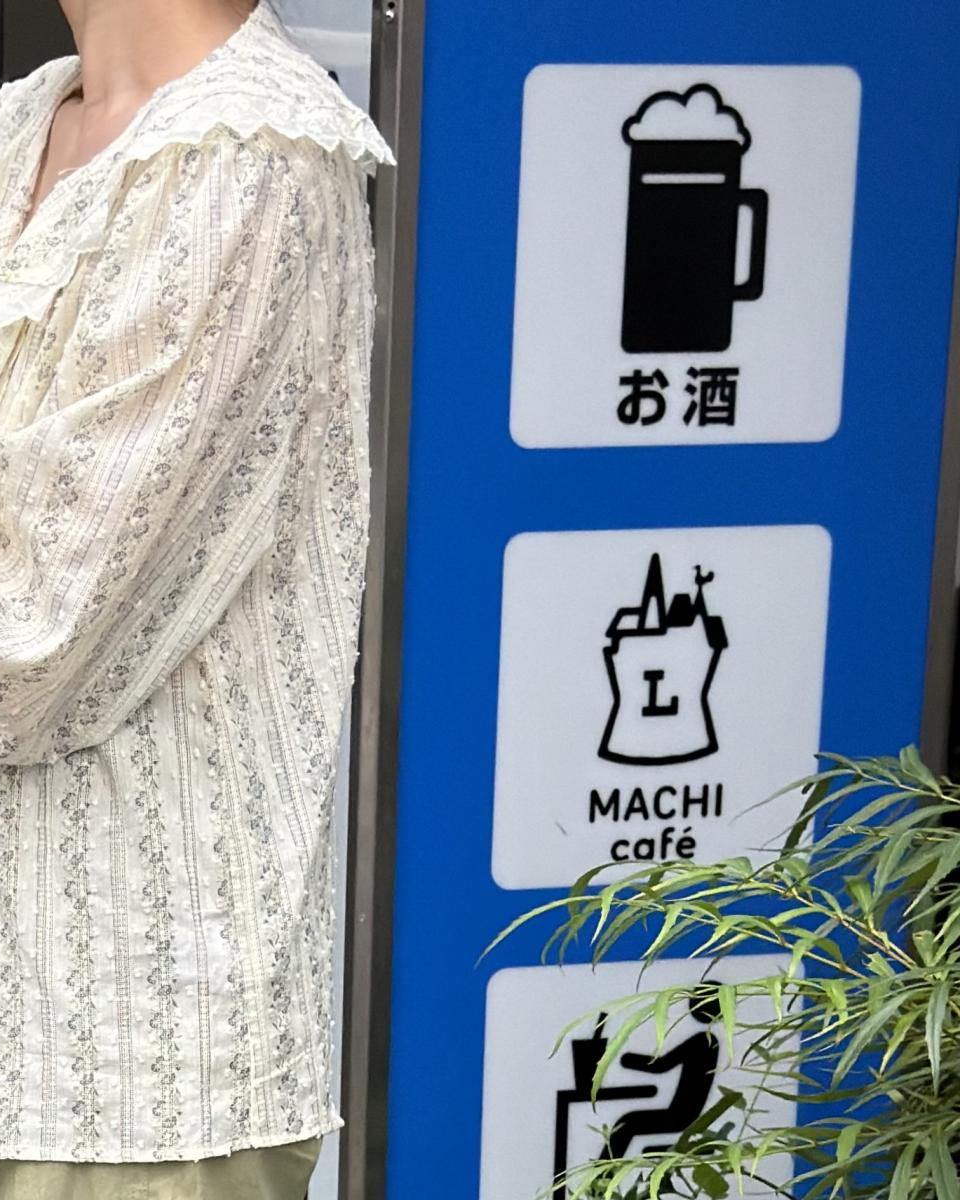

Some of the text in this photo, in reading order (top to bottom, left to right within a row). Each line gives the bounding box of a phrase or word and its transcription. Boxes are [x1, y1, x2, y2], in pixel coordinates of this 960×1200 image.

[617, 366, 740, 426] お酒
[641, 669, 679, 717] L
[589, 783, 723, 823] MACHI
[610, 826, 696, 861] café
